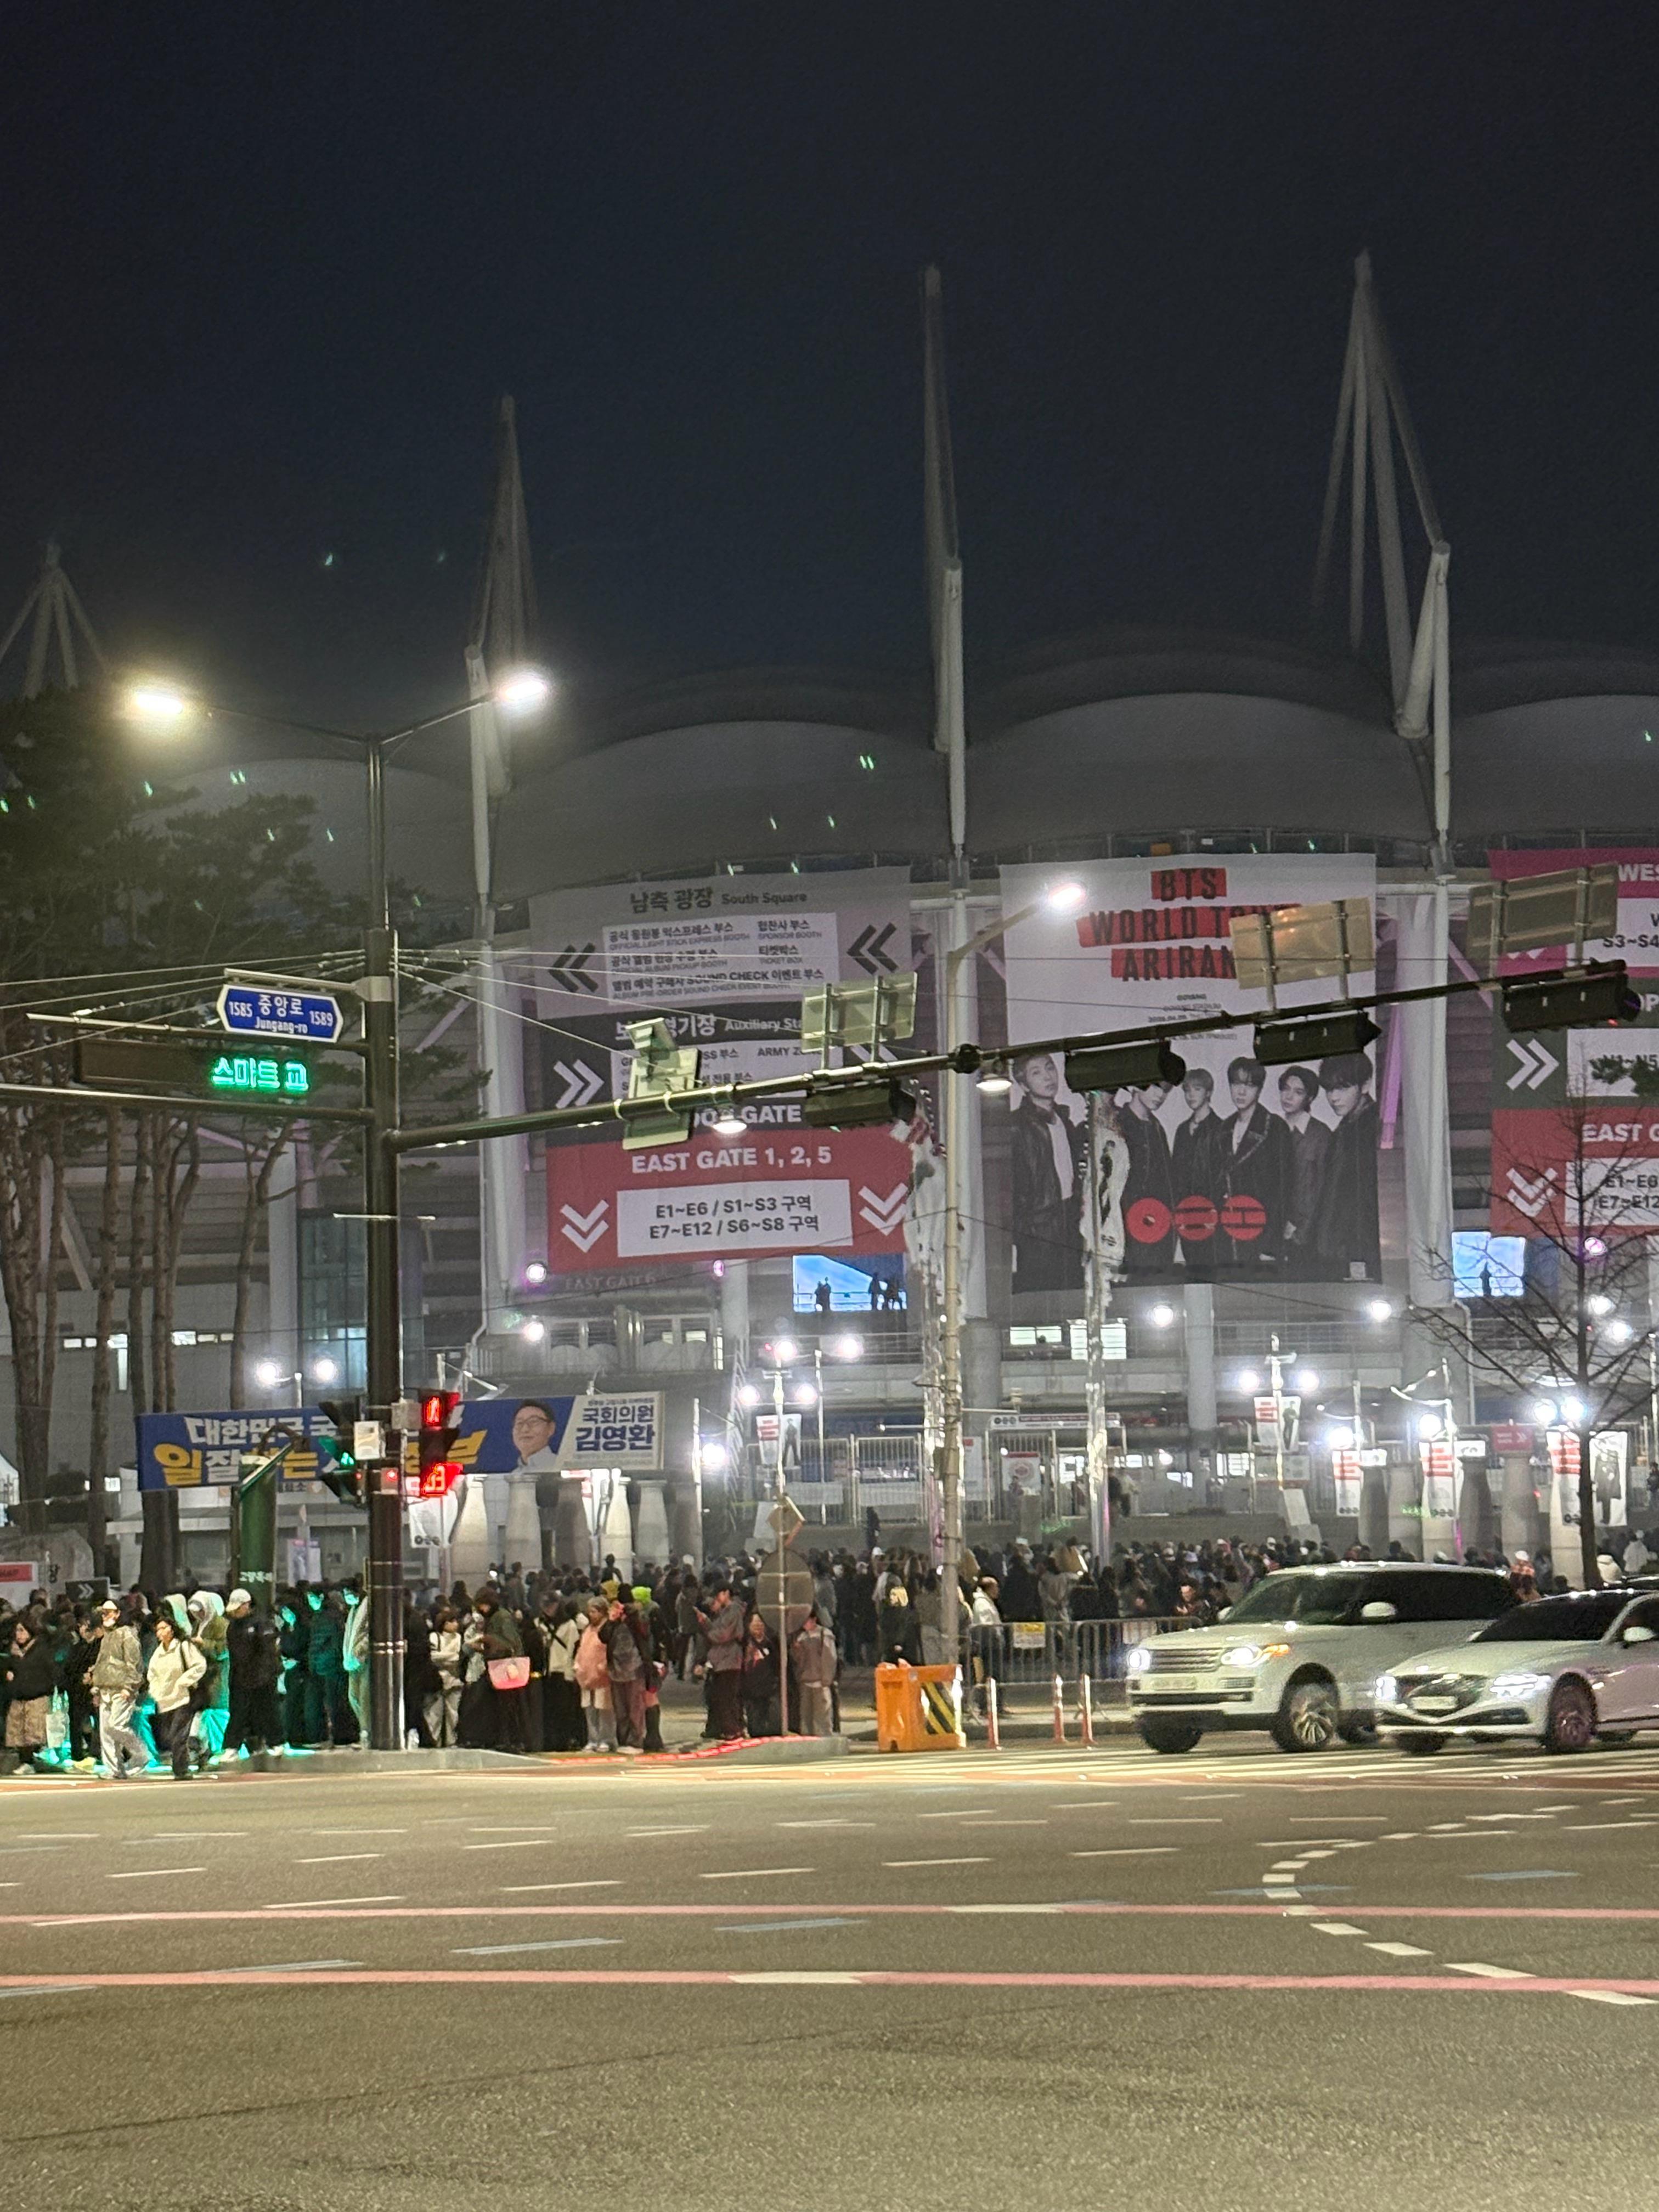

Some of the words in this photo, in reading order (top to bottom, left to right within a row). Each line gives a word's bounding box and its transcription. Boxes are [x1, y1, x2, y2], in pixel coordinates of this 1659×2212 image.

[1160, 867, 1217, 901] BTS
[630, 890, 668, 914] 남측
[674, 887, 712, 910] 광장
[721, 893, 758, 905] South
[762, 892, 807, 906] Square
[714, 922, 733, 934] 부스
[790, 918, 810, 930] 부스
[1089, 906, 1197, 944] WORLD
[1122, 945, 1237, 981] ARIRAN
[729, 970, 769, 981] CHECK
[771, 969, 802, 980] 이벤트
[804, 968, 823, 979] 부스
[228, 1001, 253, 1018] 1585
[258, 994, 304, 1017] 중앙로
[255, 1017, 308, 1034] Jungang-ro
[309, 1011, 334, 1027] 1589
[725, 1018, 781, 1032] Auxiliary
[719, 1047, 739, 1059] 부스
[758, 1047, 790, 1057] ARMY
[212, 1056, 281, 1088] 스마트
[742, 1104, 802, 1124] GATE
[1582, 1123, 1643, 1142] EAST
[632, 1153, 690, 1174] EAST
[696, 1148, 758, 1170] GATE
[765, 1149, 784, 1169] 1,
[792, 1147, 812, 1167] 2,
[818, 1146, 832, 1164] 5
[657, 1202, 708, 1218] E1~E6
[713, 1199, 719, 1216] /
[723, 1198, 777, 1213] S1~S3
[781, 1195, 811, 1211] 구역
[650, 1222, 712, 1239] E7~E12
[716, 1220, 722, 1235] /
[727, 1217, 785, 1233] S6~S8
[789, 1215, 819, 1232] 구역
[583, 1404, 654, 1424] 국회의원
[576, 1424, 655, 1452] 김영환
[154, 1443, 319, 1486] 일잘는
